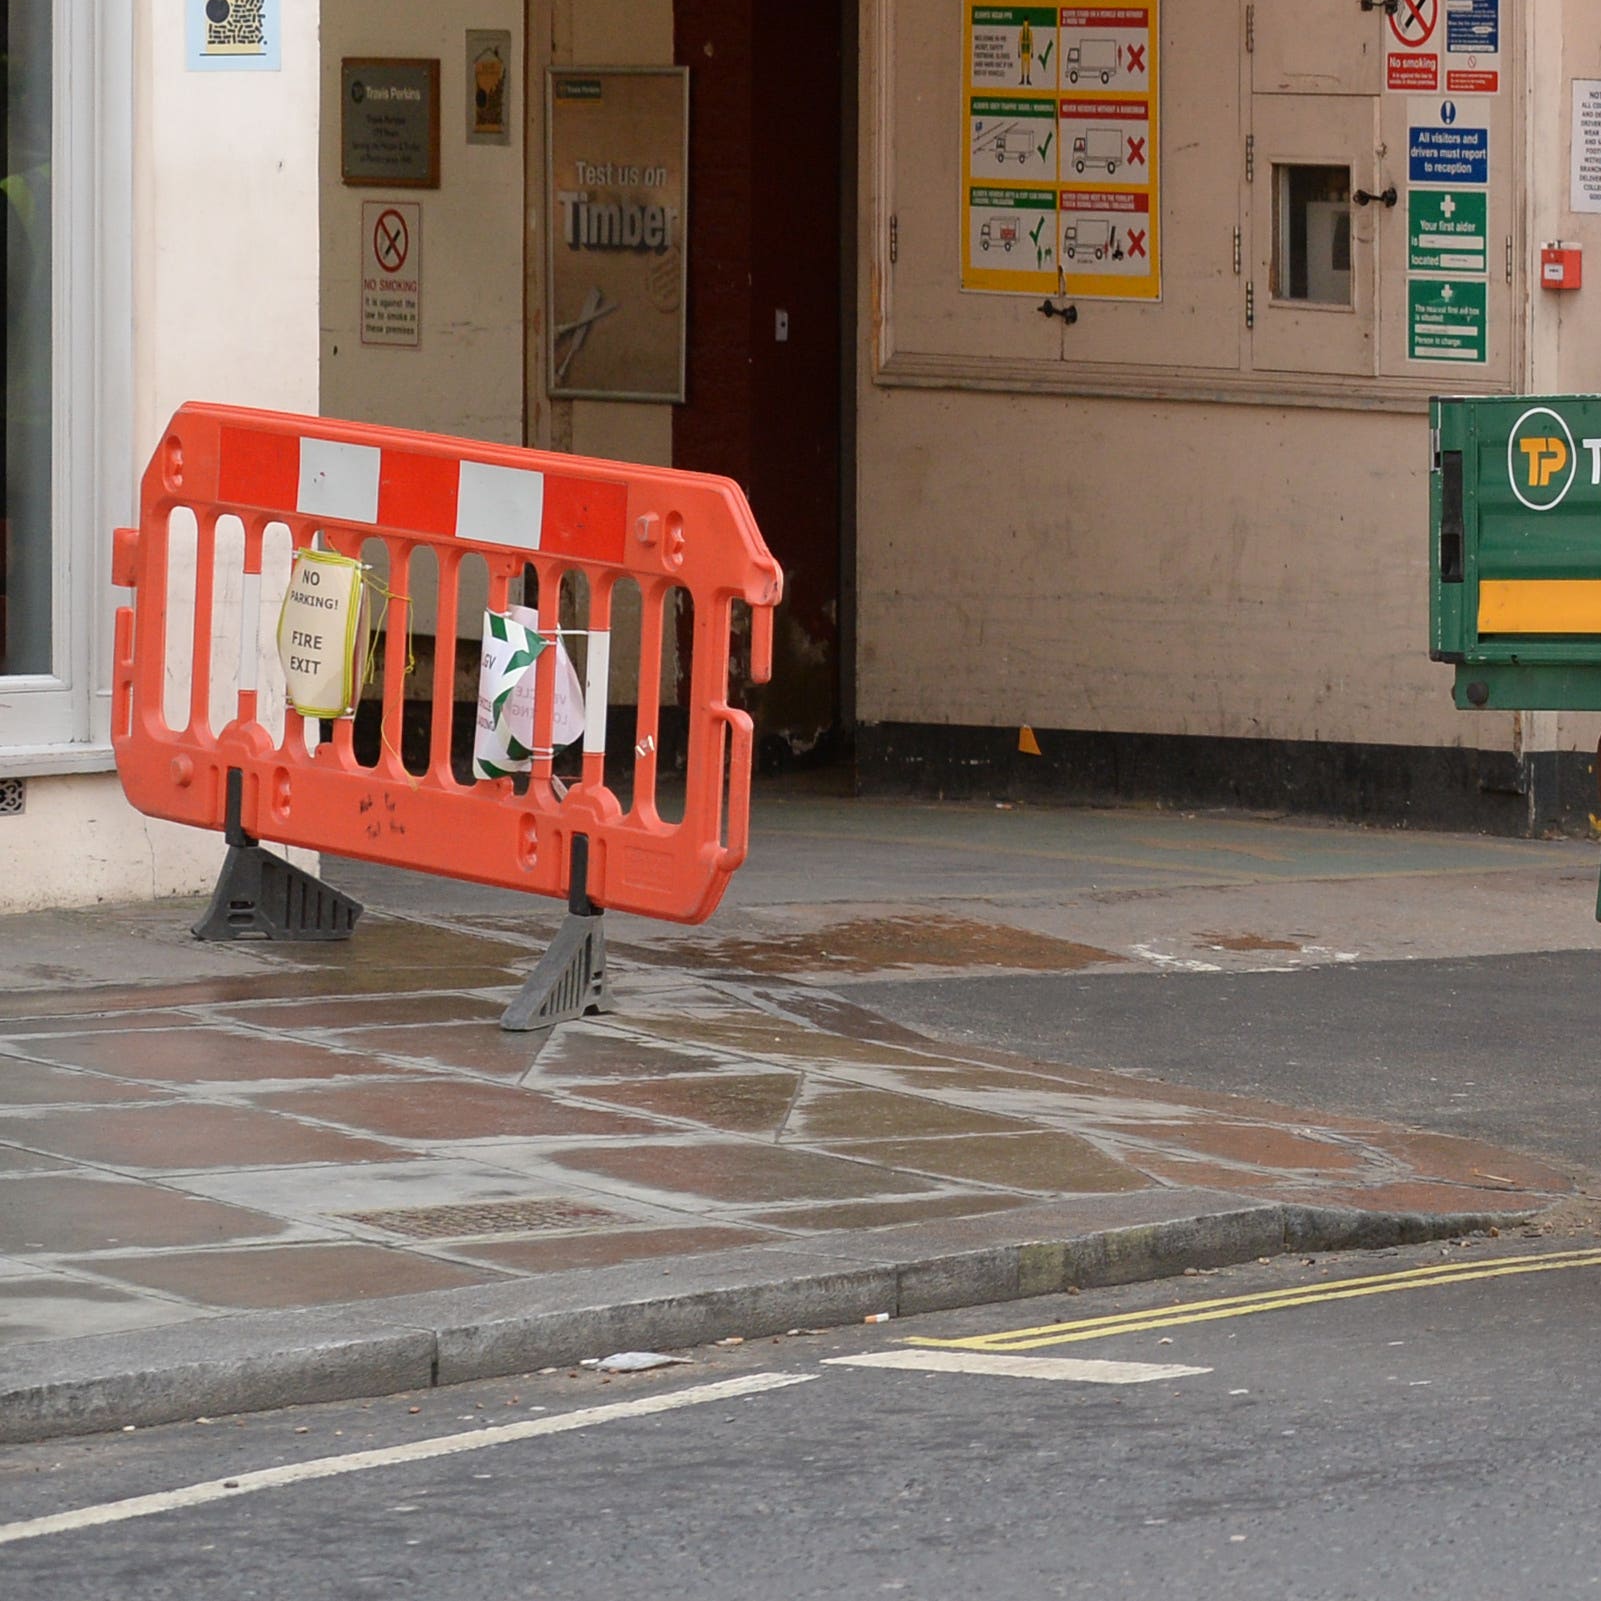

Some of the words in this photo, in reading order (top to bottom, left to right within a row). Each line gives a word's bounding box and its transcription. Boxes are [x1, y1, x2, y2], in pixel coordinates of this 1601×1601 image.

[1390, 57, 1400, 67] No
[1403, 58, 1436, 71] smoking
[1418, 133, 1429, 143] All
[1432, 133, 1459, 144] visitors
[1462, 133, 1478, 144] and
[1411, 146, 1438, 157] drivers
[1440, 148, 1460, 158] must
[1462, 149, 1486, 160] report
[576, 161, 613, 185] Test
[618, 168, 639, 185] us
[645, 168, 666, 186] on
[1425, 161, 1433, 172] to
[1434, 161, 1472, 174] reception
[557, 192, 678, 248] Timber
[1420, 220, 1437, 231] Your
[1439, 220, 1454, 231] first
[1456, 221, 1476, 232] aider
[1411, 236, 1418, 246] is
[1412, 255, 1439, 266] located
[364, 279, 376, 291] NO
[380, 280, 417, 292] SMOKING
[1519, 436, 1567, 487] TP
[302, 569, 320, 585] NO
[291, 590, 338, 610] PARKING!
[292, 631, 323, 650] FIRE
[290, 656, 321, 675] EXIT
